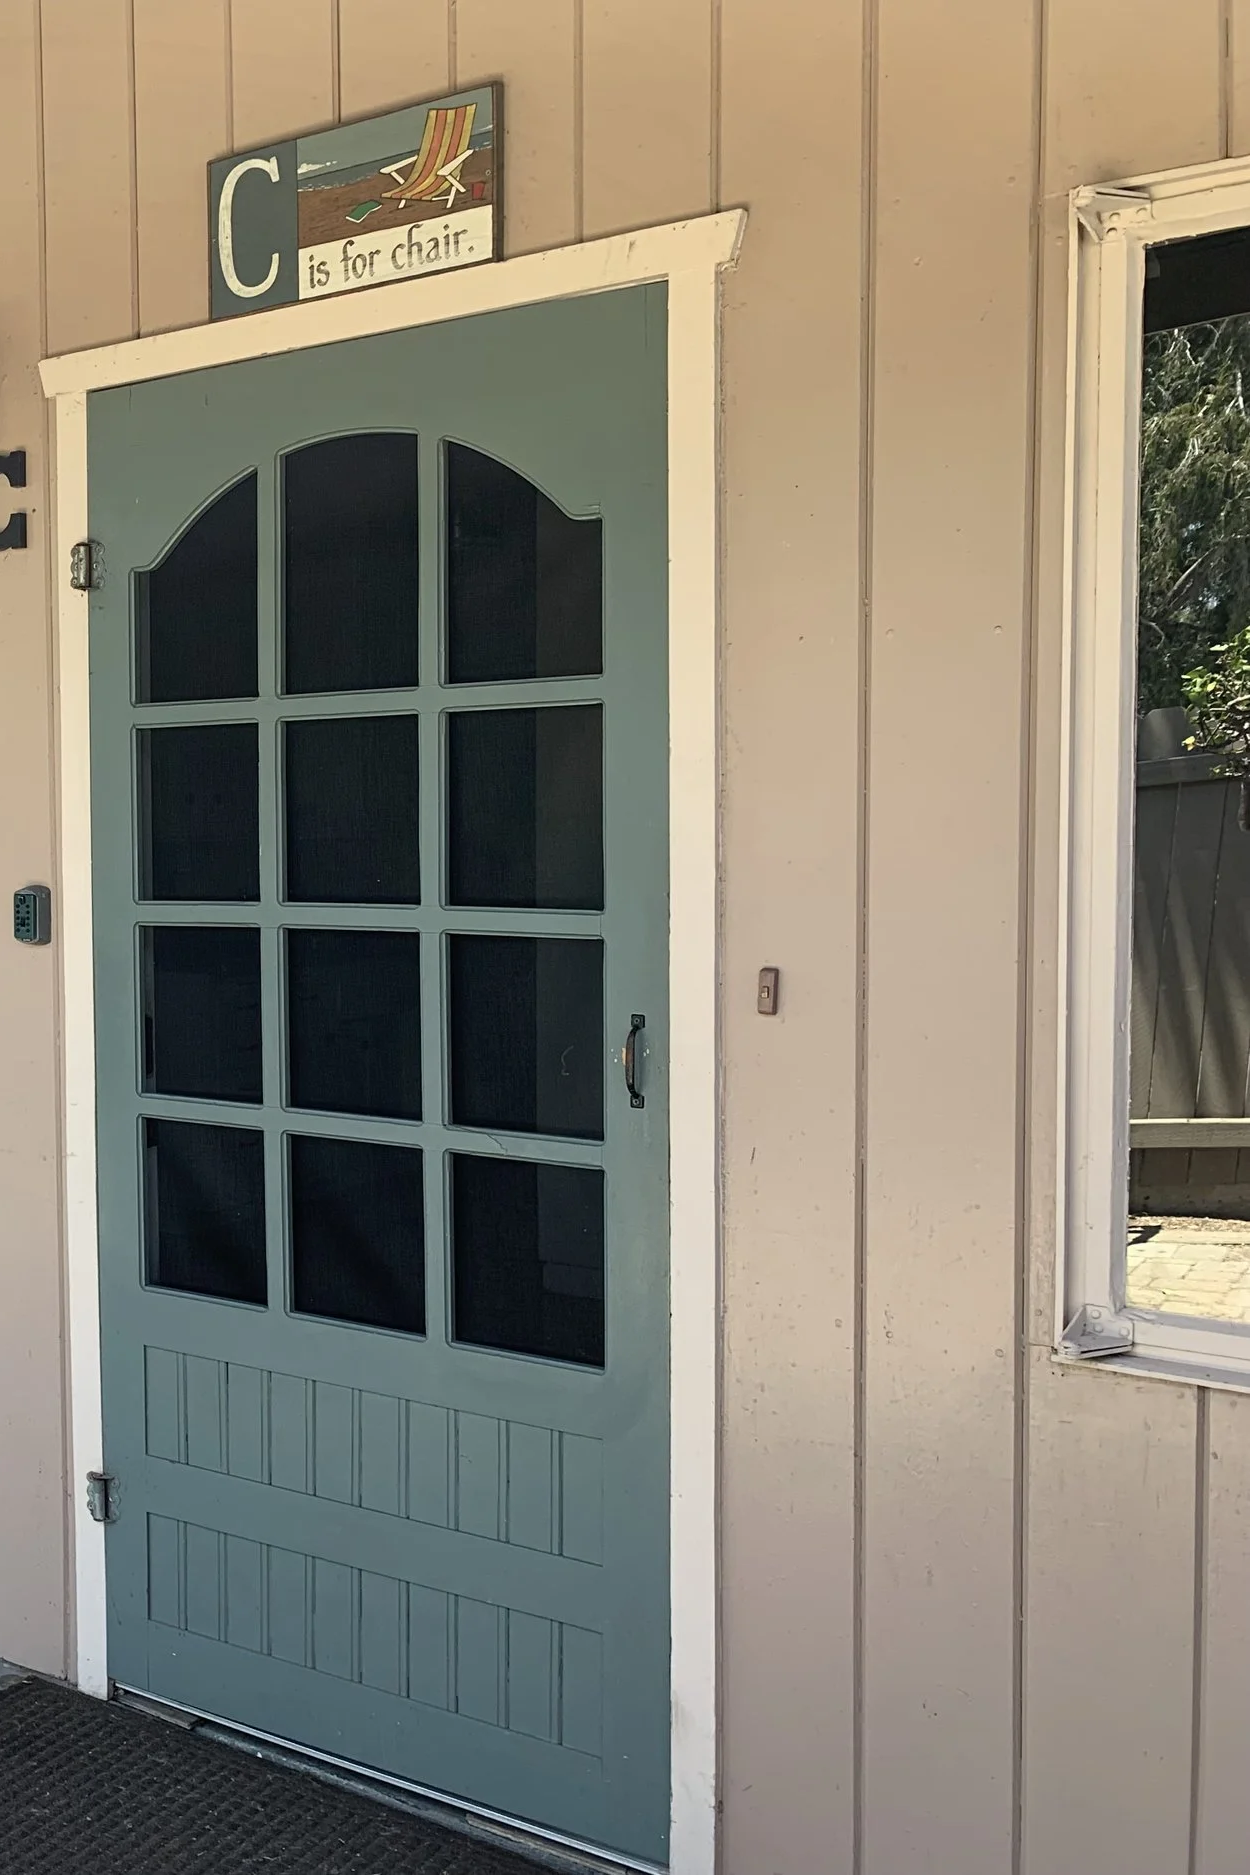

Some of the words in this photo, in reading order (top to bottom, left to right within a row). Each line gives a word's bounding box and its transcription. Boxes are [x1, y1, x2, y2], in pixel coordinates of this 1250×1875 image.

[218, 155, 280, 298] C
[308, 254, 330, 289] is
[340, 239, 381, 283] for
[391, 223, 475, 271] chair.
